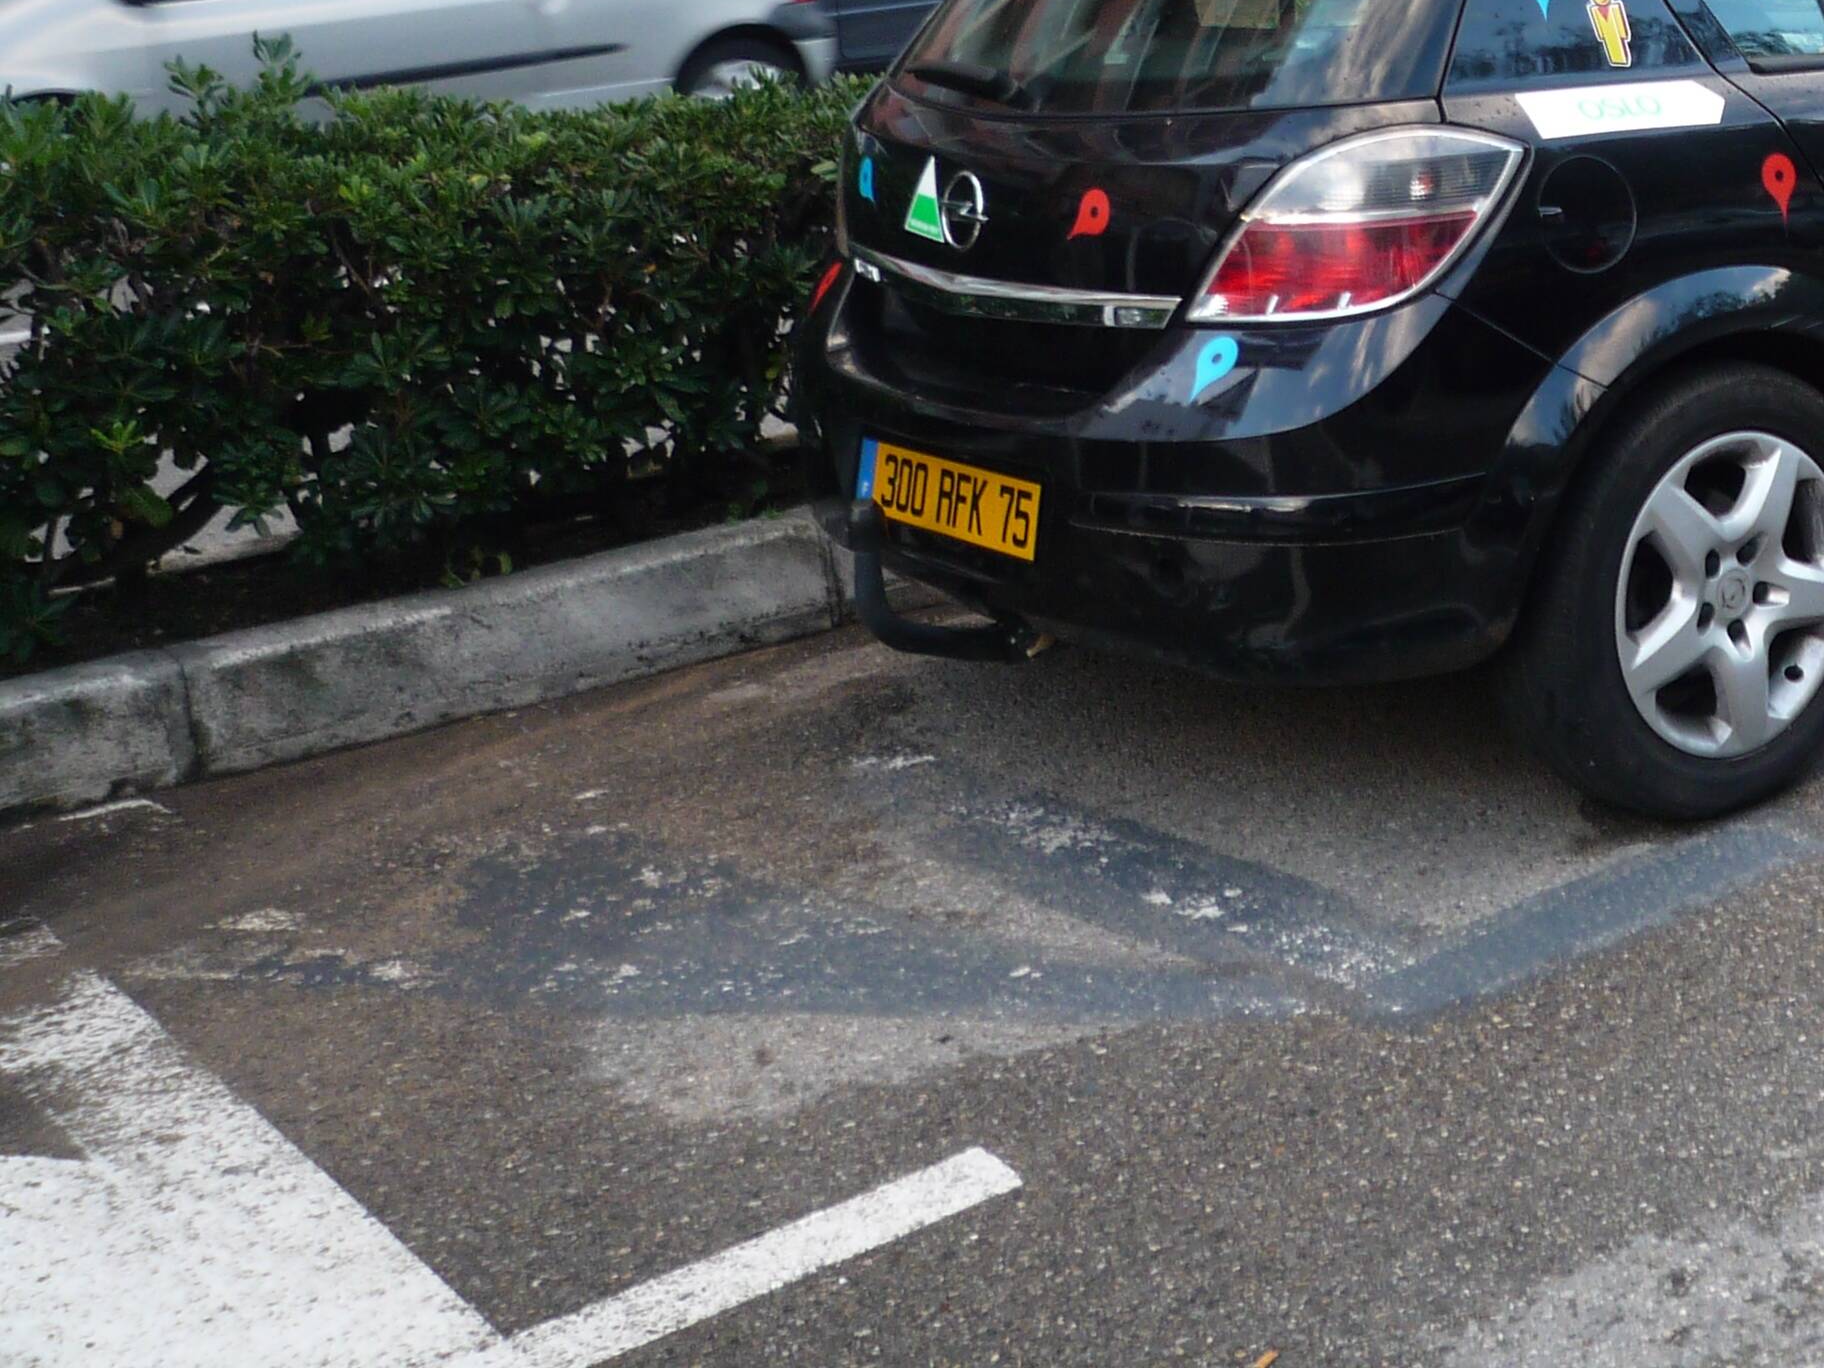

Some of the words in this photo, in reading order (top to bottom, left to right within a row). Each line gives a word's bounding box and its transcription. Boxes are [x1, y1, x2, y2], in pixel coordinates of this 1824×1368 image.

[1576, 95, 1664, 122] OSLO
[880, 453, 929, 518] 300
[935, 466, 989, 536] RFK
[998, 483, 1034, 550] 75
